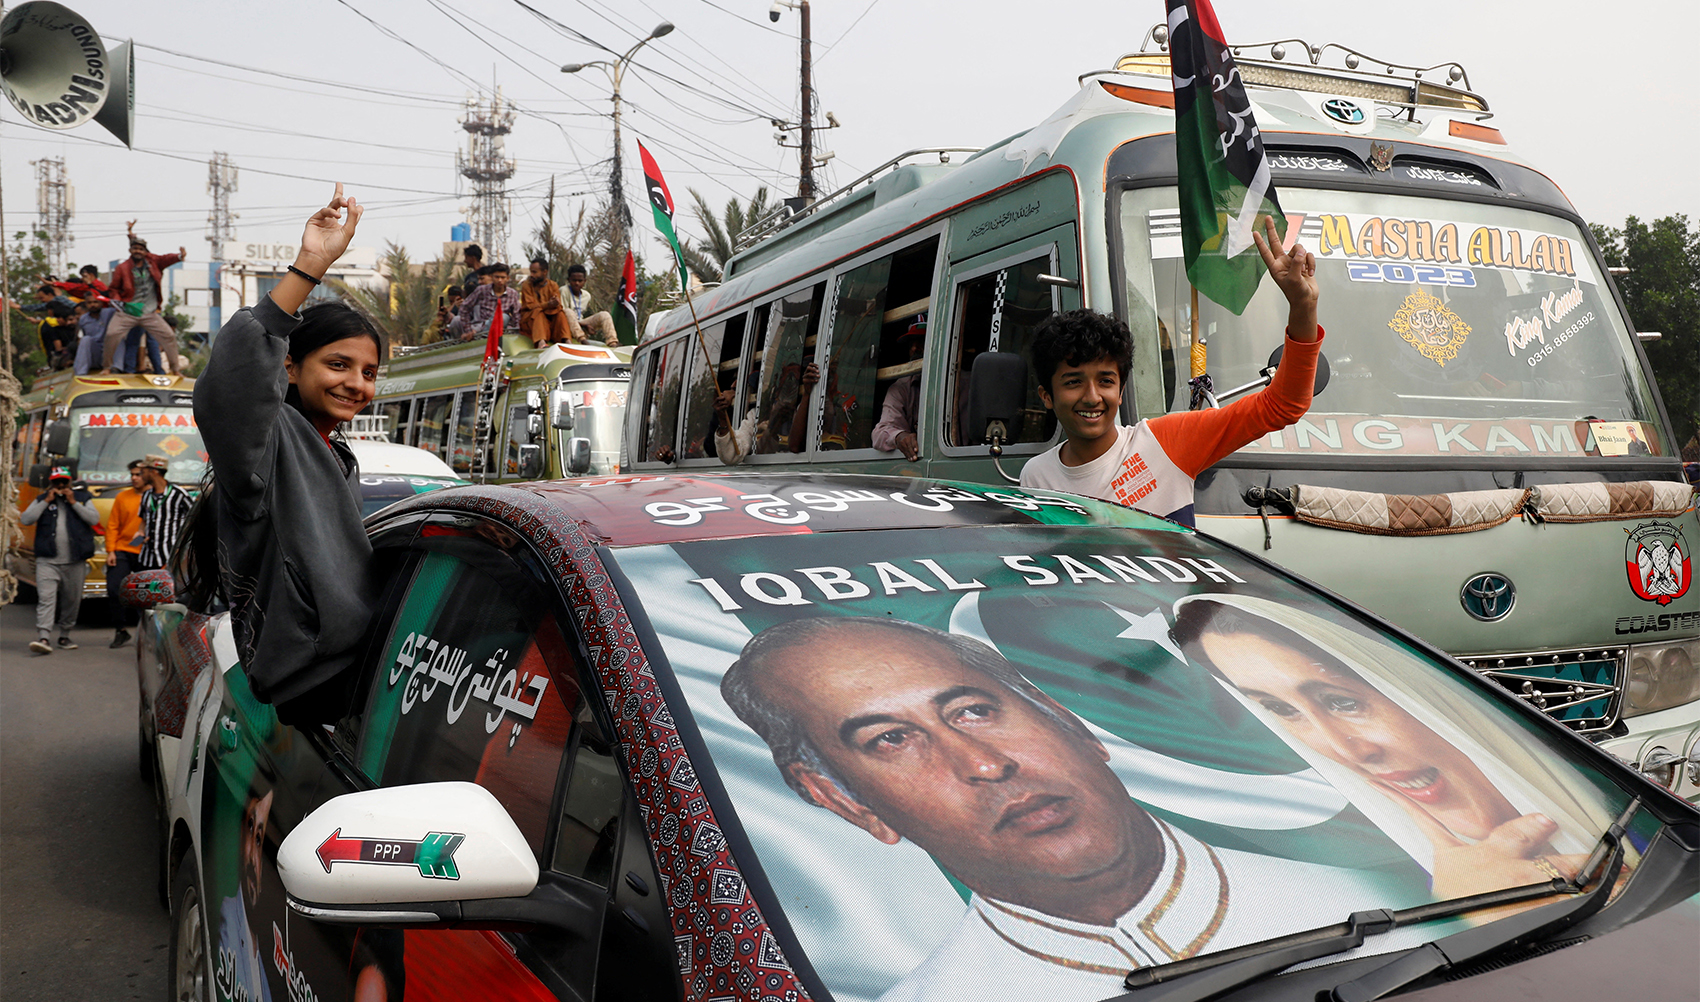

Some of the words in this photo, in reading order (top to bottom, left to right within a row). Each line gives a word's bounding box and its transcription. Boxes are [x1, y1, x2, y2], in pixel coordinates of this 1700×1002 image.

[71, 25, 104, 80] SOUND
[1319, 214, 1462, 264] MASHA
[1467, 227, 1577, 277] ALLAH
[1347, 262, 1477, 288] 2023
[1504, 316, 1545, 357] King
[1540, 278, 1584, 330] Kamal
[1527, 311, 1595, 367] 0315.8658392
[1246, 419, 1404, 450] ING
[1110, 461, 1148, 490] FUTURE
[1122, 452, 1142, 469] THE
[1115, 488, 1127, 500] IS
[1120, 478, 1158, 507] BRIGHT
[690, 558, 987, 612] IQBAL
[999, 554, 1247, 586] SANDH
[373, 843, 401, 860] PPP
